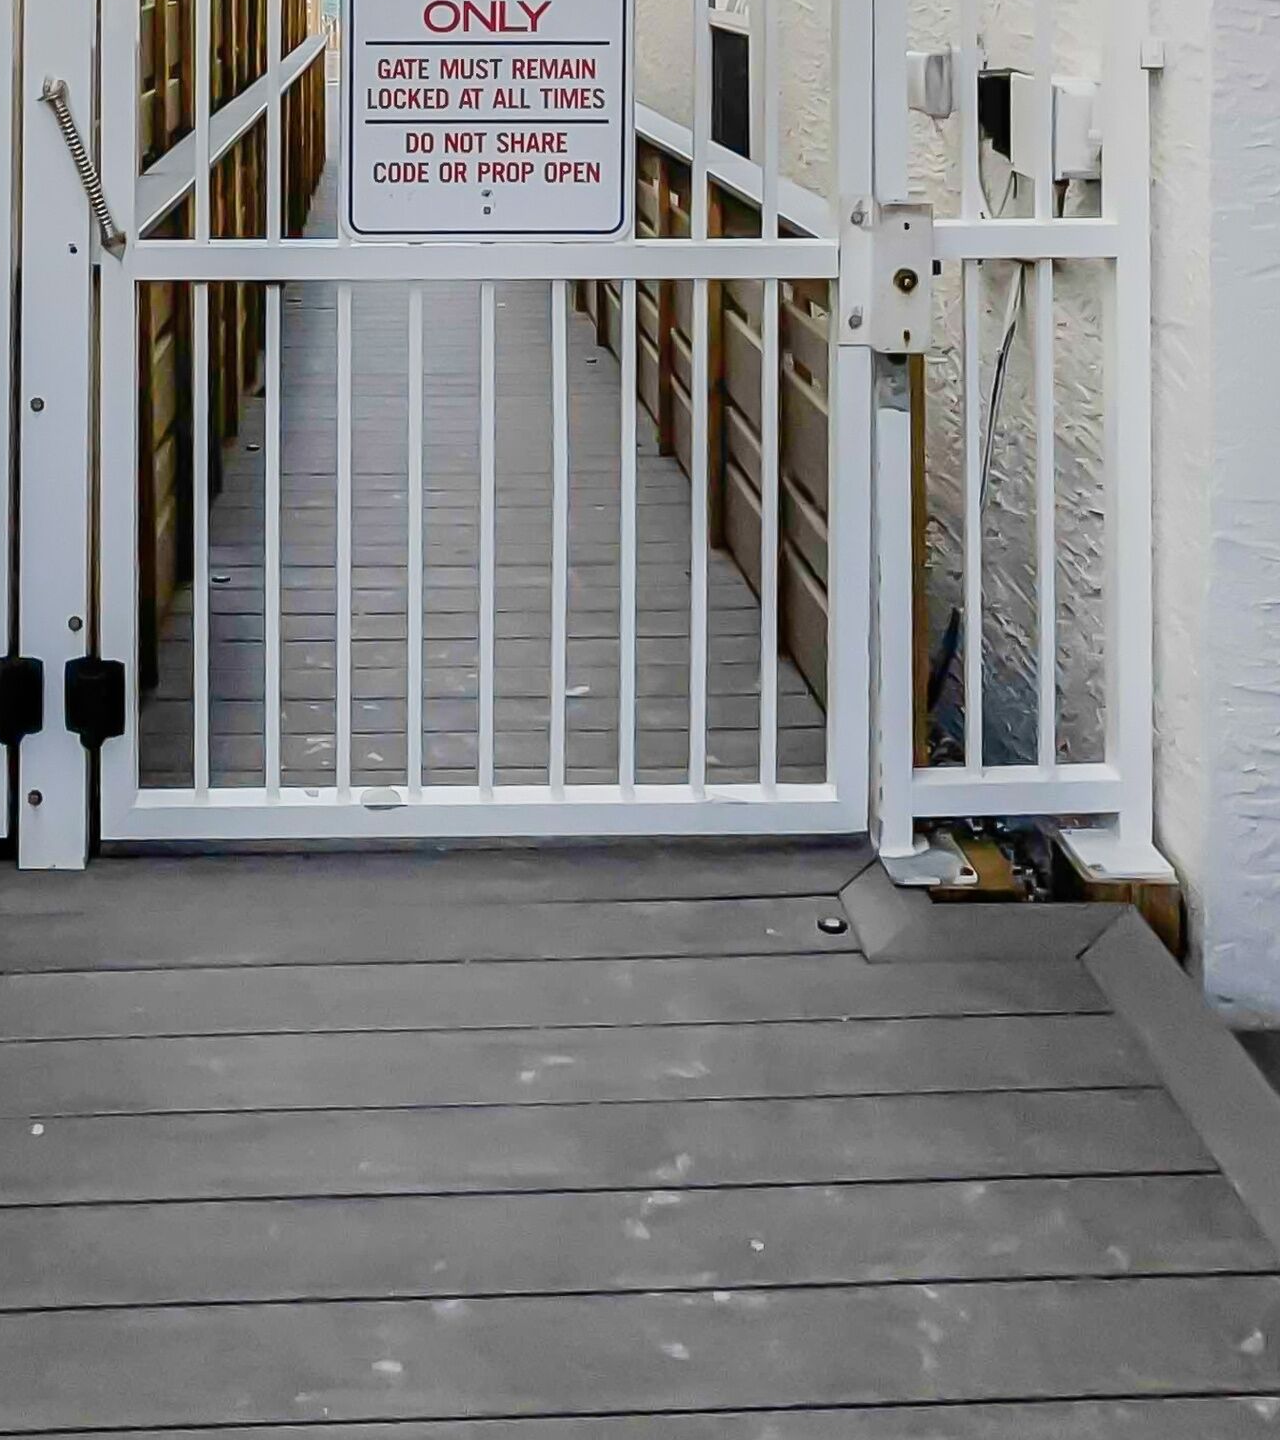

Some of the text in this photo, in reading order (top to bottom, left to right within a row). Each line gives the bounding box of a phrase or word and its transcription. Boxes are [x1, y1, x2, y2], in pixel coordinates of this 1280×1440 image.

[423, 0, 551, 33] ONLY
[377, 59, 595, 79] GATE MUST REMAIN
[367, 89, 605, 109] LOCKED AT ALL TIMES
[406, 133, 568, 153] DO NOT SHARE
[373, 163, 600, 183] CODE OR PROP OPEN
